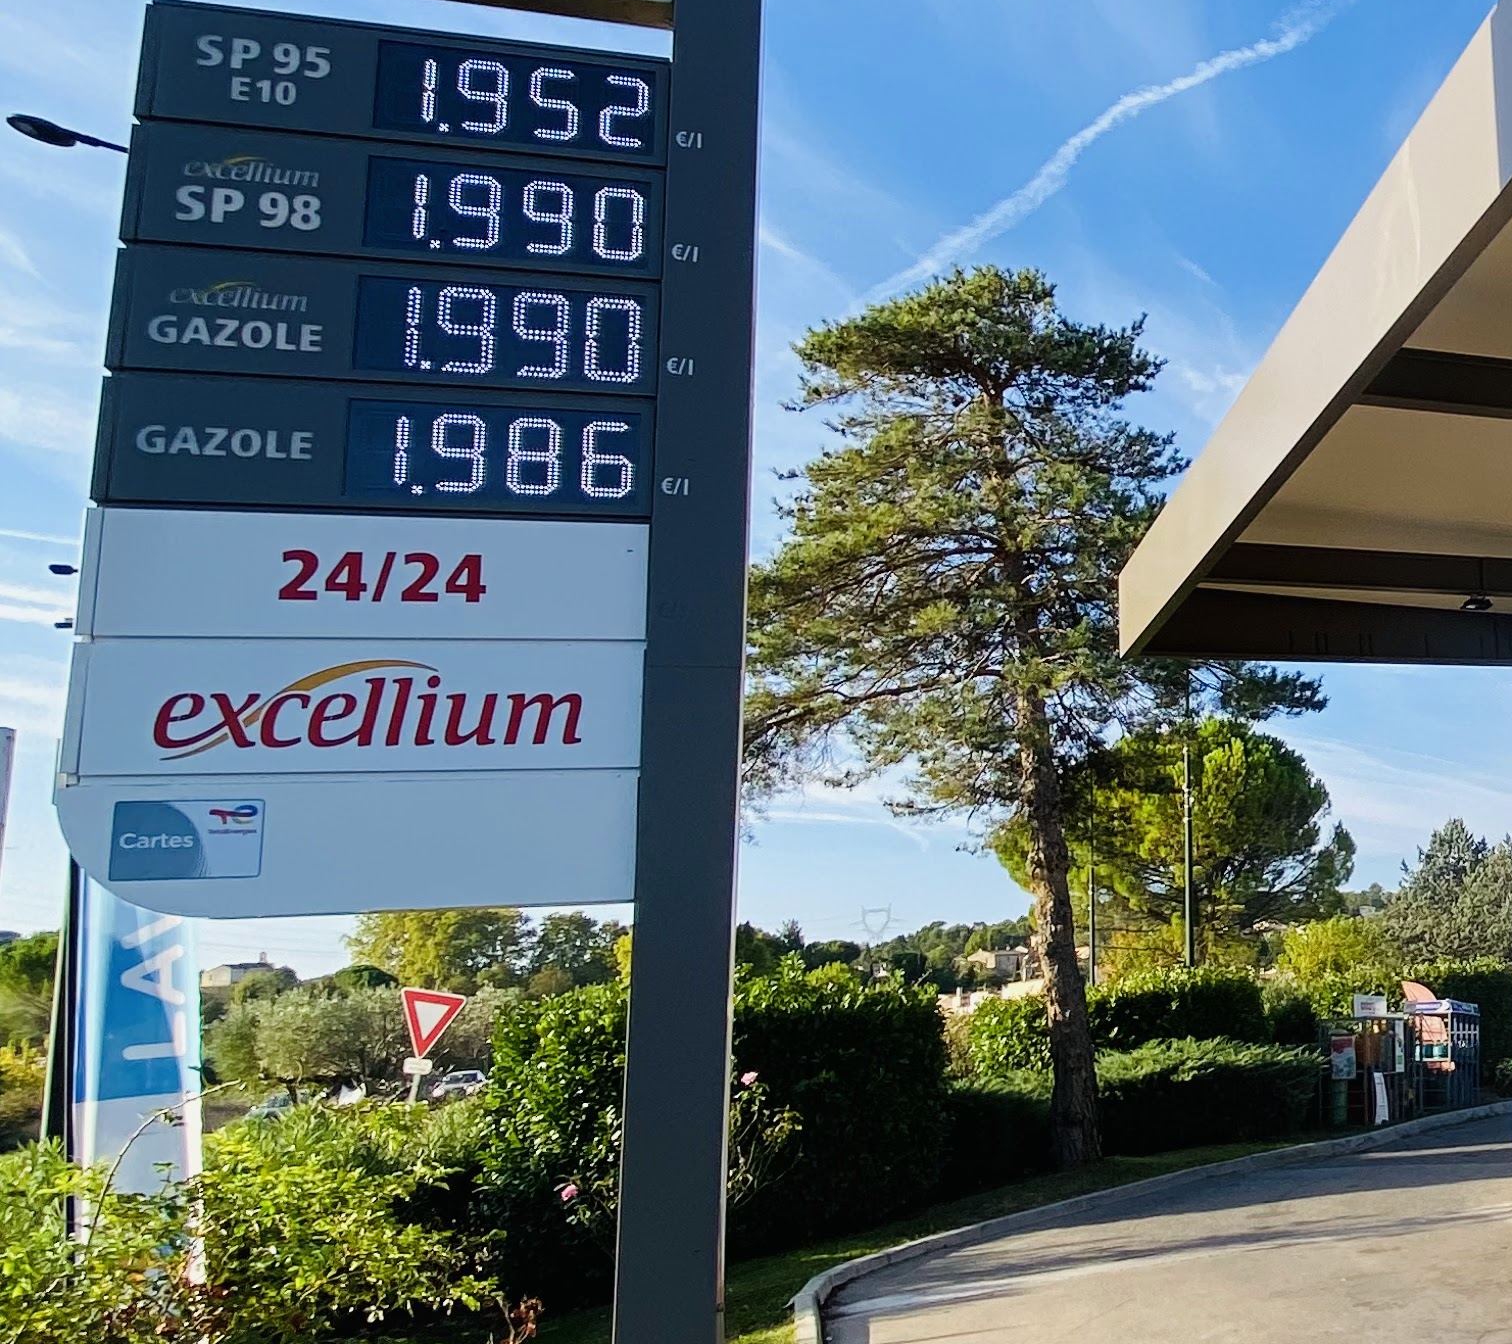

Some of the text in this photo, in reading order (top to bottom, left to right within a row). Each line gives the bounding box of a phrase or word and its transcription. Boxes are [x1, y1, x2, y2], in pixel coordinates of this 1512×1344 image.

[196, 34, 332, 79] SP 95
[229, 76, 298, 106] E10
[420, 58, 650, 148] 1.952
[183, 157, 320, 188] excellium
[175, 184, 322, 232] SP 98
[412, 173, 645, 261] 1.990
[168, 283, 308, 313] excellium
[147, 314, 323, 352] GAZOLE
[403, 286, 643, 384] 1.990
[135, 424, 315, 460] GAZOLE
[393, 413, 636, 498] 1.986
[278, 548, 487, 603] 24/24
[152, 668, 583, 752] excellium
[118, 832, 195, 849] Cartes
